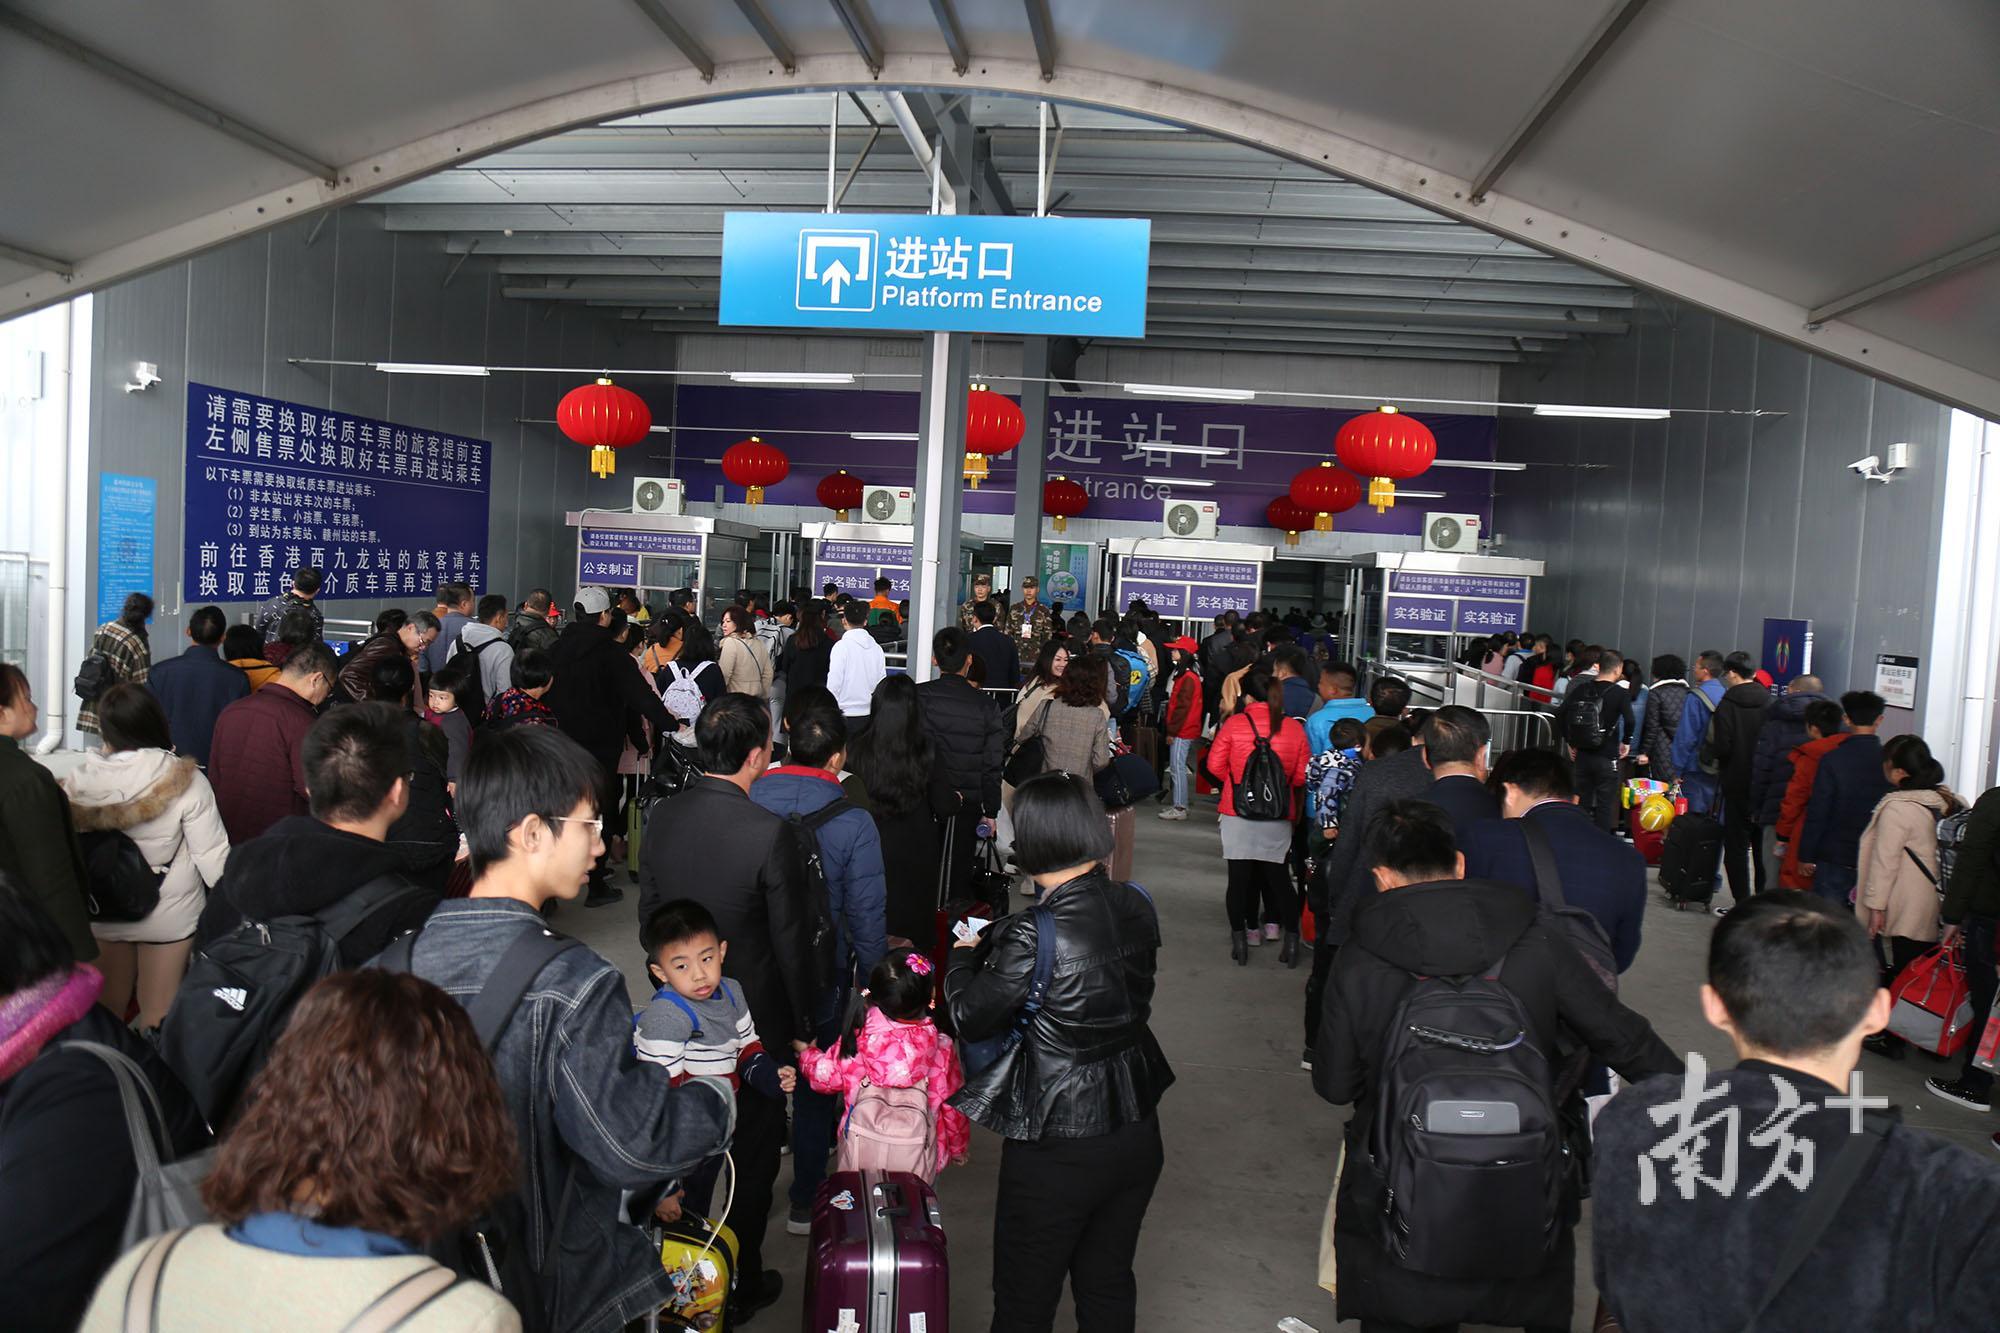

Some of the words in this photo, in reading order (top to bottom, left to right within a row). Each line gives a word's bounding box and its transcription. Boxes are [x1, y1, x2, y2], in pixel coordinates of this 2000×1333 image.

[885, 236, 1014, 281] 进站口
[882, 286, 984, 309] Platform
[991, 289, 1103, 313] Entrance
[206, 394, 482, 464] 请需要换取纸质车票的旅客提前至
[1047, 409, 1245, 470] 进站口
[205, 424, 481, 485] 左侧售票处换取好车票再进站乘车
[1047, 473, 1172, 500] trance
[200, 542, 481, 570] 前往香港西九龙站的旅客请先
[583, 562, 635, 576] 公安制证
[822, 575, 870, 590] 实名验证
[1127, 592, 1179, 607] 实名验证
[1196, 596, 1249, 611] 实名验证
[1394, 607, 1447, 622] 实名验证
[1464, 611, 1517, 625] 实名验证
